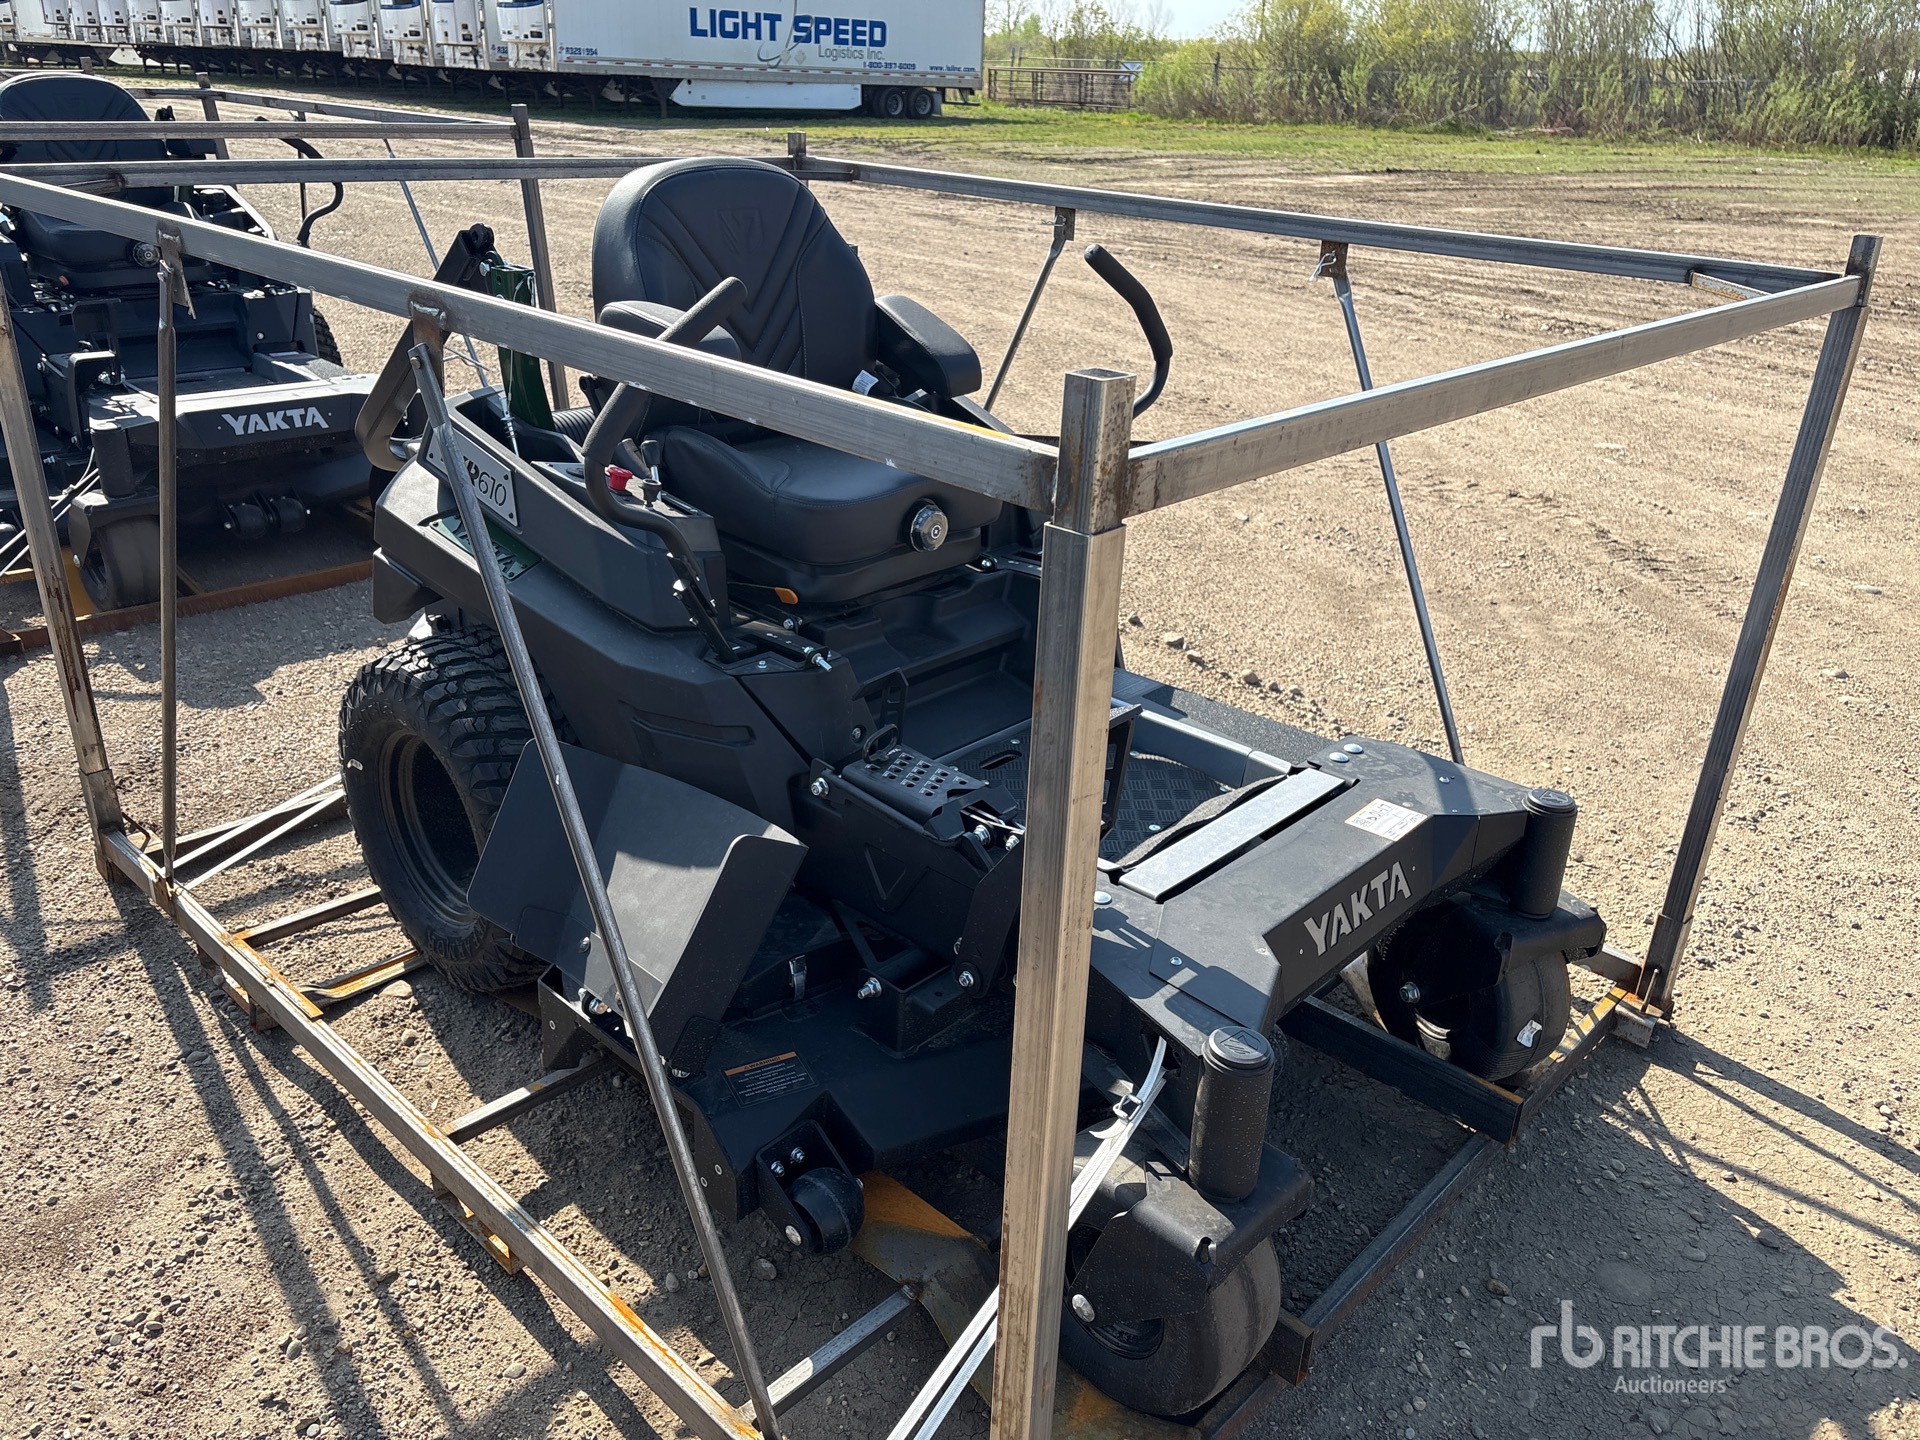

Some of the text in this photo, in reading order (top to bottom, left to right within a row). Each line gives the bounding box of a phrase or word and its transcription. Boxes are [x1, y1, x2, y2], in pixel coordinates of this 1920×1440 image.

[689, 7, 886, 47] LIGHT SPEED
[818, 45, 886, 62] Logistics Inc.
[221, 407, 329, 436] YAKTA
[1303, 861, 1412, 956] YAKTA
